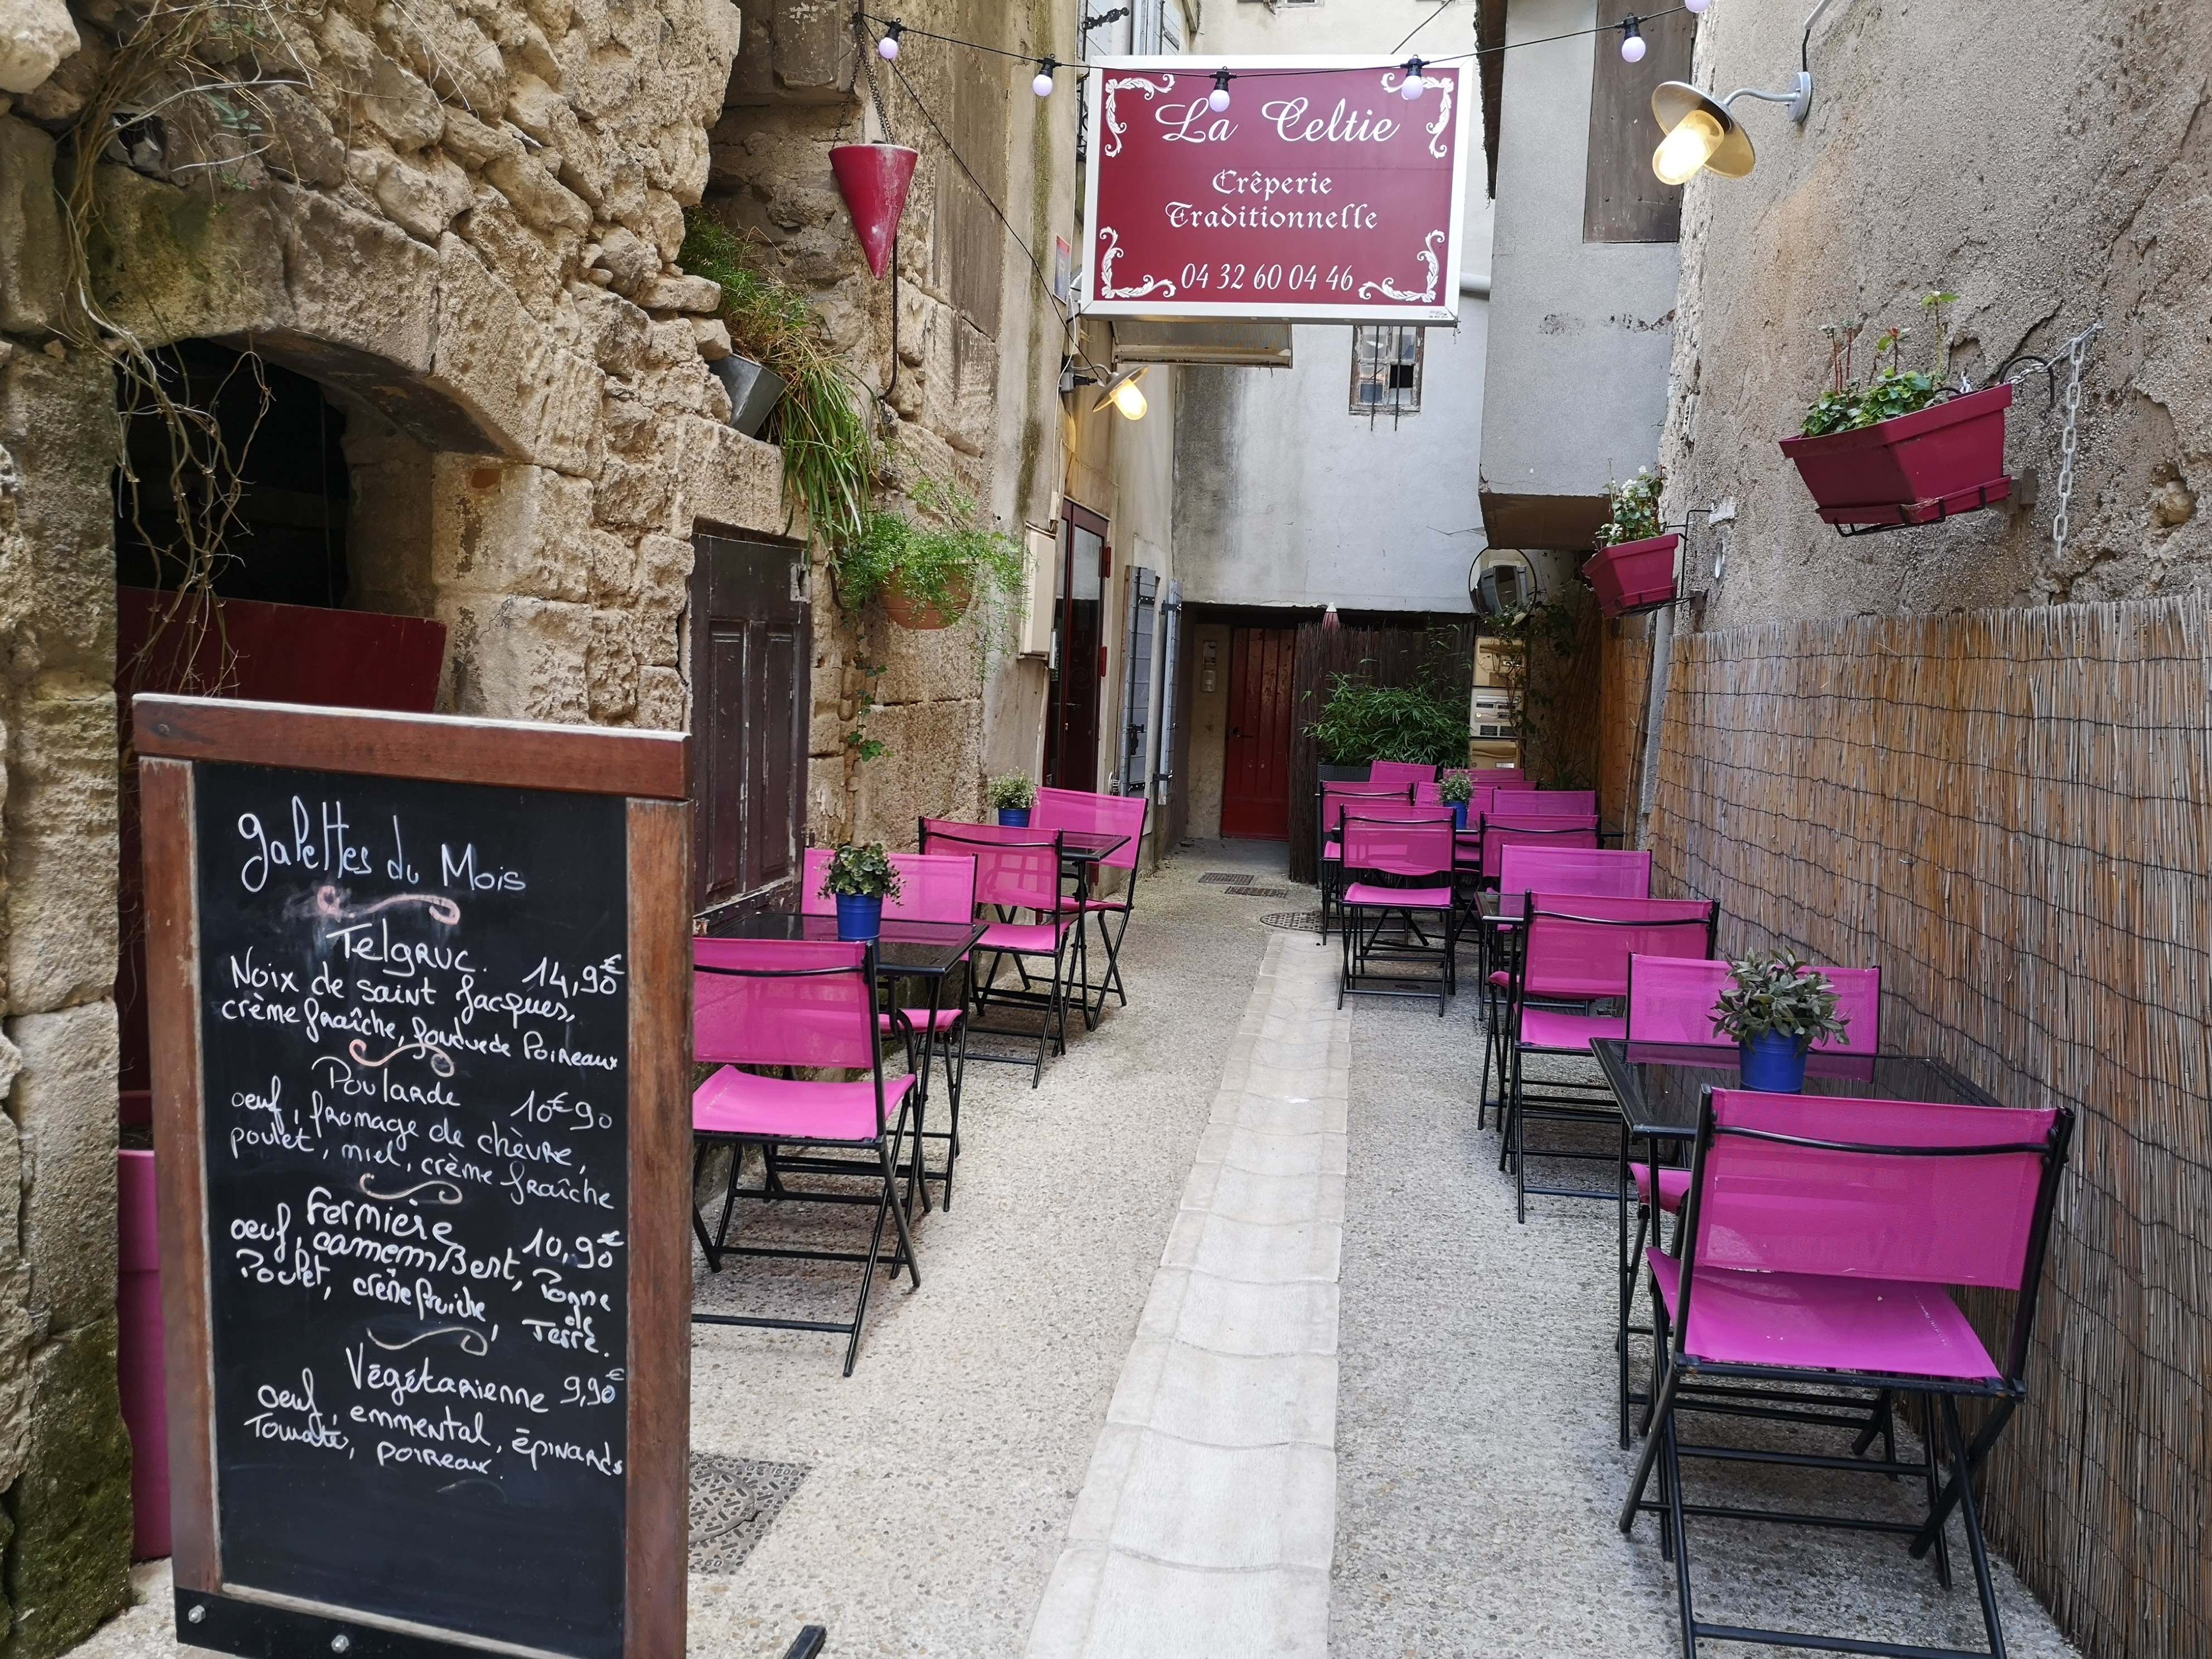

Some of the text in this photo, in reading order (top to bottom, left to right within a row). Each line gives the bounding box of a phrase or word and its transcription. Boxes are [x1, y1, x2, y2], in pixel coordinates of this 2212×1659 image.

[1155, 97, 1400, 143] La Celtie
[1212, 169, 1332, 201] Crêperie
[1166, 201, 1377, 229] Traditionnelle
[1181, 263, 1353, 291] 04 32 60 04 46
[388, 815, 419, 885] du
[442, 843, 526, 890] Mois
[231, 946, 299, 992] Noix
[312, 961, 345, 998] de
[222, 992, 301, 1023] crème
[304, 998, 404, 1047] fraîche,
[312, 1056, 460, 1107] Poularde
[310, 1090, 419, 1151] fromage
[429, 1118, 464, 1148] de
[421, 1153, 492, 1185] crème
[501, 1161, 614, 1209] fraîche
[565, 1305, 594, 1338] de
[512, 1428, 623, 1476] épinards
